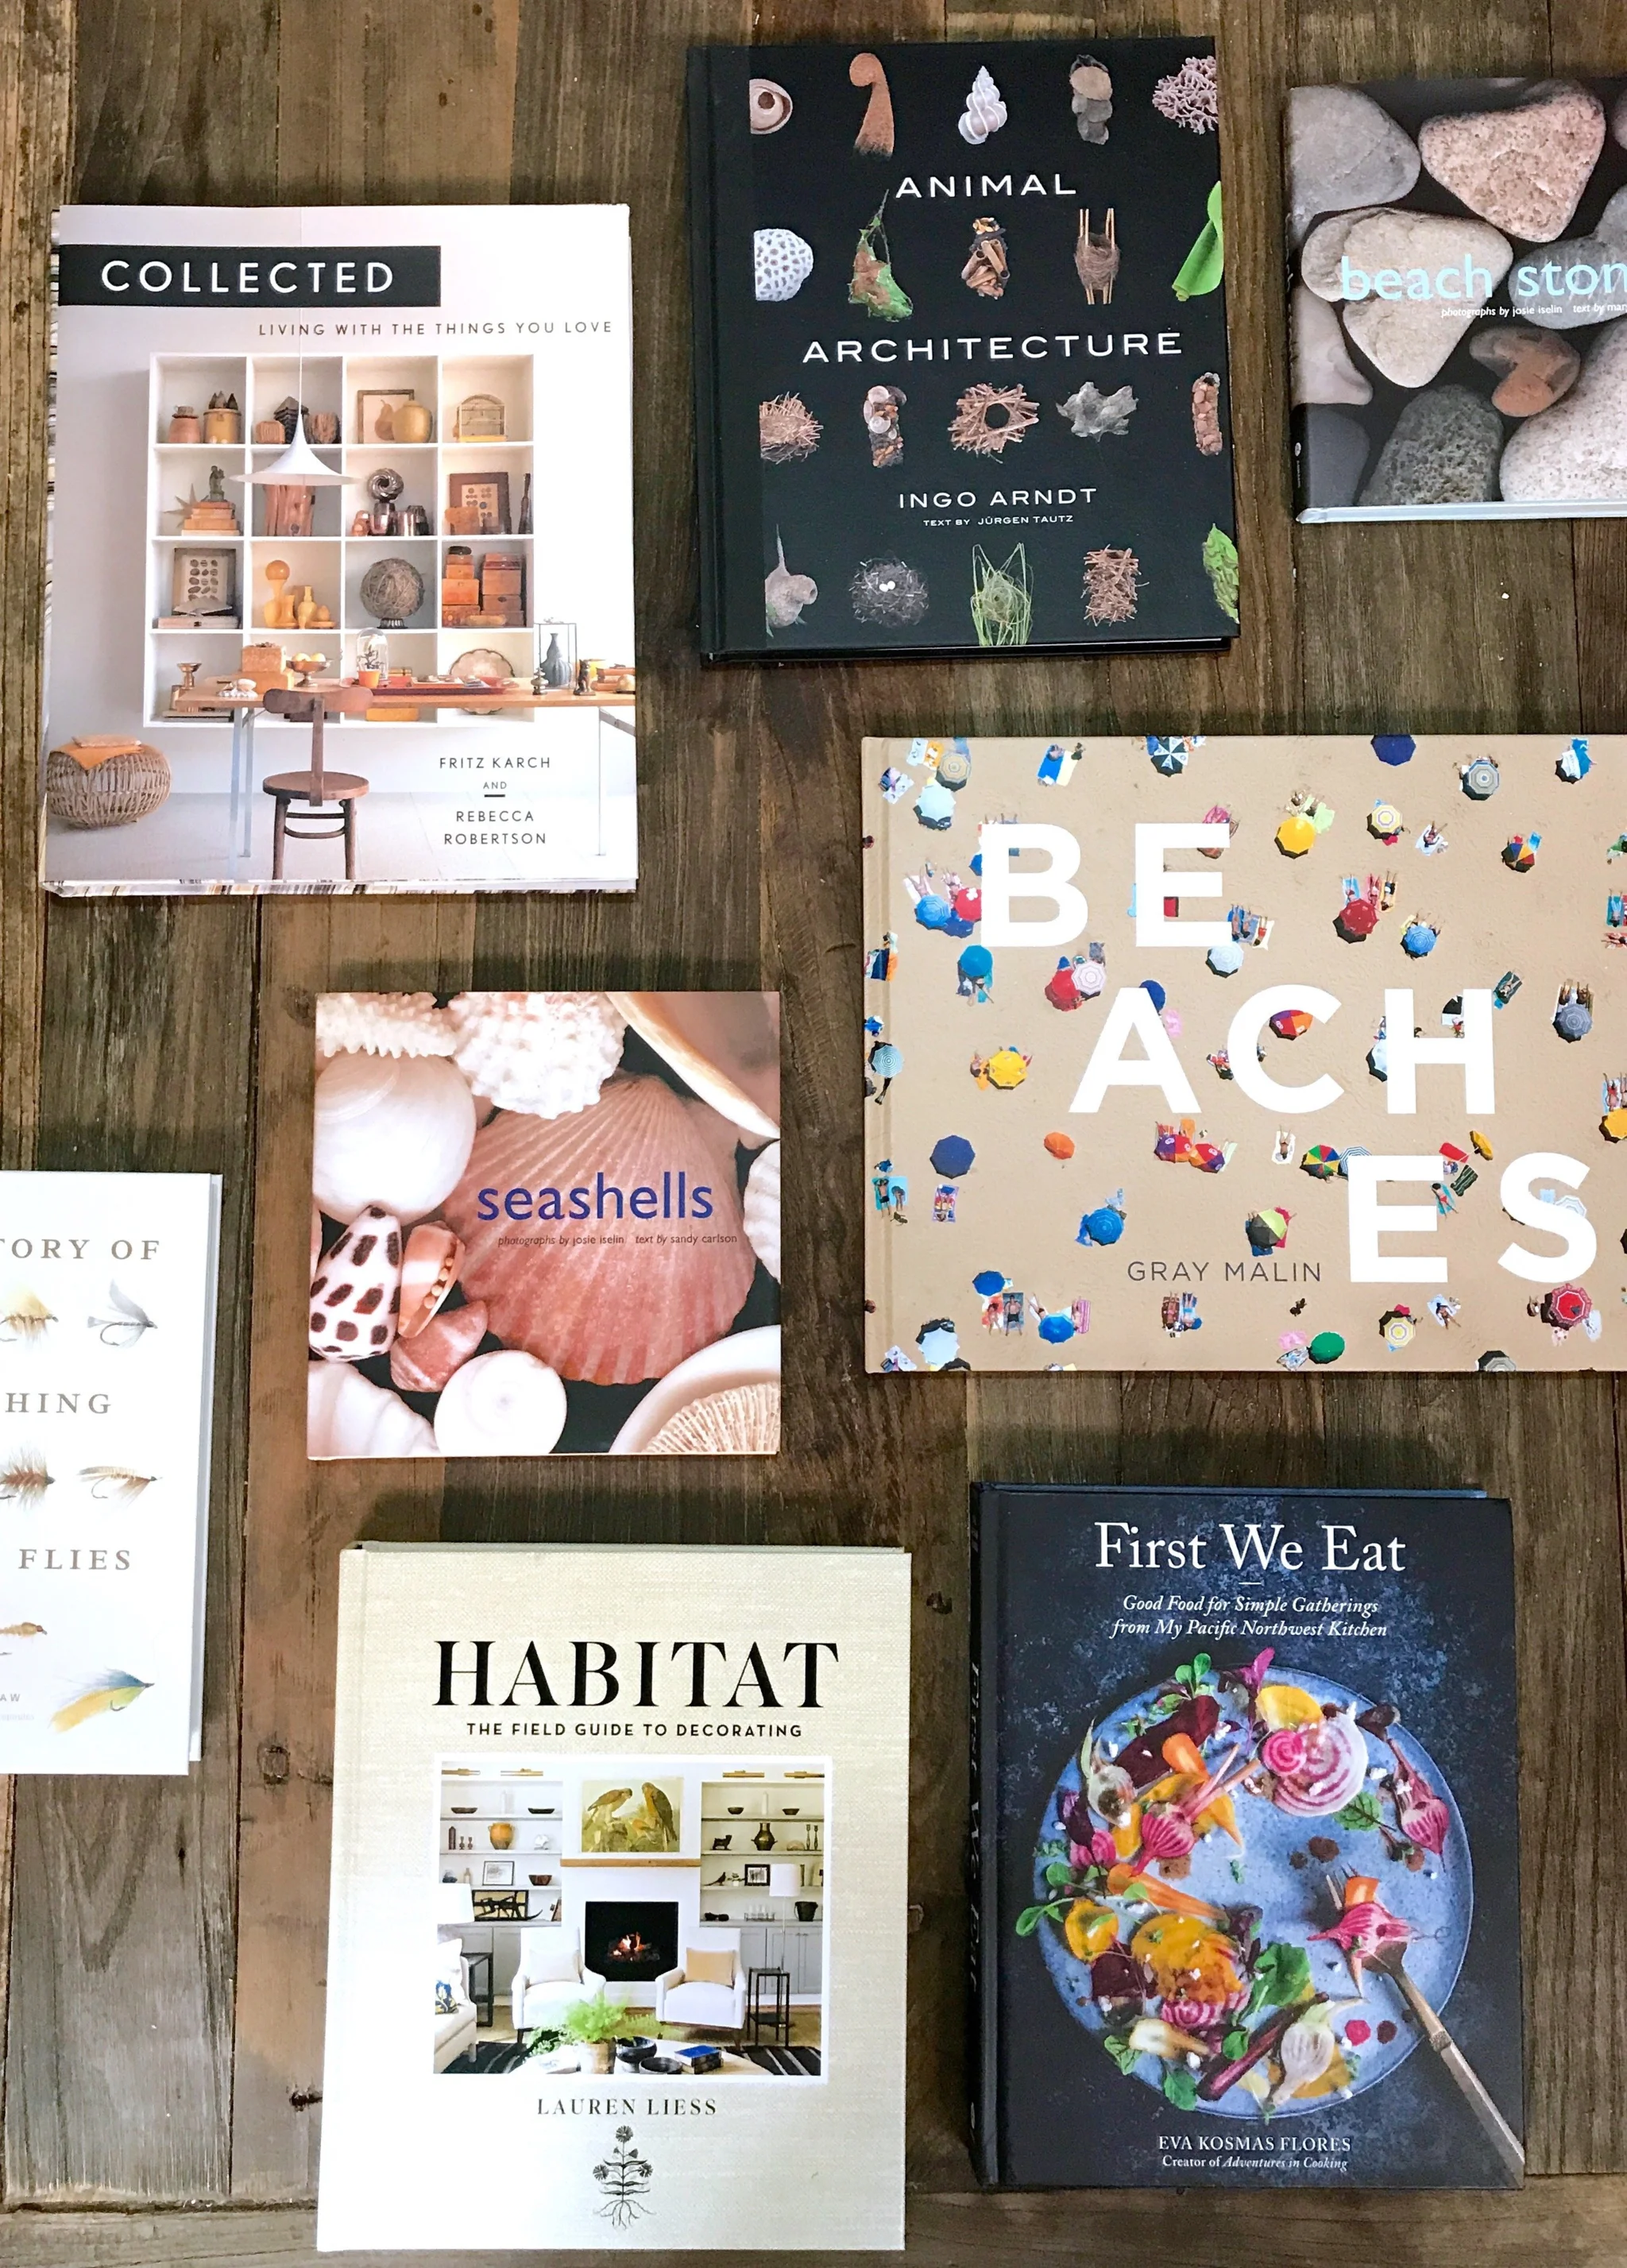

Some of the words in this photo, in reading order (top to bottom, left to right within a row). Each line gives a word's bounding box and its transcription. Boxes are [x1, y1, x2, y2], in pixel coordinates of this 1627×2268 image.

[895, 174, 1077, 199] ANIMAL
[100, 260, 395, 294] COLLECTED
[1341, 253, 1494, 301] beach
[1517, 261, 1627, 296] ston
[1441, 307, 1497, 318] photographs
[1499, 306, 1510, 317] by
[1513, 305, 1536, 316] josie
[1538, 306, 1563, 315] iselin
[1594, 303, 1605, 315] by
[258, 324, 326, 336] LIVING
[336, 323, 383, 335] WITH
[392, 323, 426, 335] THE
[435, 322, 506, 335] THINGS
[515, 322, 555, 334] YOU
[564, 321, 613, 334] LOVE
[802, 332, 1183, 364] ARCHITECTURE
[899, 492, 976, 509] INGO
[990, 488, 1097, 506] ARNDT
[977, 514, 1030, 525] JÜRGEN
[1034, 515, 1073, 524] TAUTZ
[439, 757, 485, 769] FRITZ
[493, 756, 551, 769] KARCH
[455, 810, 535, 822] REBECCA
[443, 833, 547, 845] ROBERTSON
[979, 821, 1231, 948] BE
[1069, 983, 1495, 1114] ACH
[477, 1171, 713, 1221] seashells
[1347, 1151, 1596, 1284] ES
[0, 1238, 90, 1259] ORY
[111, 1239, 160, 1260] OF
[498, 1235, 555, 1247] photographs
[559, 1235, 570, 1246] by
[572, 1235, 596, 1246] josie
[600, 1234, 624, 1244] iselin
[636, 1235, 654, 1244] text
[657, 1234, 667, 1246] by
[671, 1234, 698, 1245] sandy
[701, 1234, 737, 1243] carlson
[1127, 1261, 1211, 1281] GRAY
[1224, 1261, 1321, 1282] MALIN
[5, 1393, 111, 1414] HING
[1094, 1521, 1206, 1571] First
[1219, 1523, 1304, 1571] We
[1323, 1524, 1406, 1571] Eat
[18, 1548, 131, 1571] FLIES
[1123, 1595, 1163, 1613] Good
[1167, 1595, 1204, 1613] Food
[1204, 1595, 1231, 1616] for
[1235, 1596, 1287, 1615] Simple
[1291, 1595, 1378, 1617] Gatherings
[1110, 1618, 1151, 1639] from
[1155, 1619, 1184, 1639] My
[1188, 1619, 1239, 1638] Pacific
[1242, 1619, 1324, 1637] Northwest
[1327, 1619, 1387, 1637] Kitchen
[432, 1640, 839, 1709] HABITAT
[466, 1723, 502, 1737] THE
[511, 1723, 565, 1737] FIELD
[574, 1723, 634, 1737] GUIDE
[643, 1724, 667, 1737] TO
[676, 1724, 802, 1737] DECORATING
[537, 2097, 636, 2114] LAUREN
[646, 2097, 717, 2115] LIESS
[1158, 2135, 1193, 2151] EVA
[1197, 2135, 1274, 2151] KOSMAS
[1279, 2135, 1351, 2152] FLORES
[1162, 2155, 1206, 2168] Creator
[1208, 2155, 1223, 2168] of
[1222, 2156, 1285, 2169] Adventures
[1287, 2157, 1300, 2168] in
[1302, 2156, 1348, 2173] Cooking
